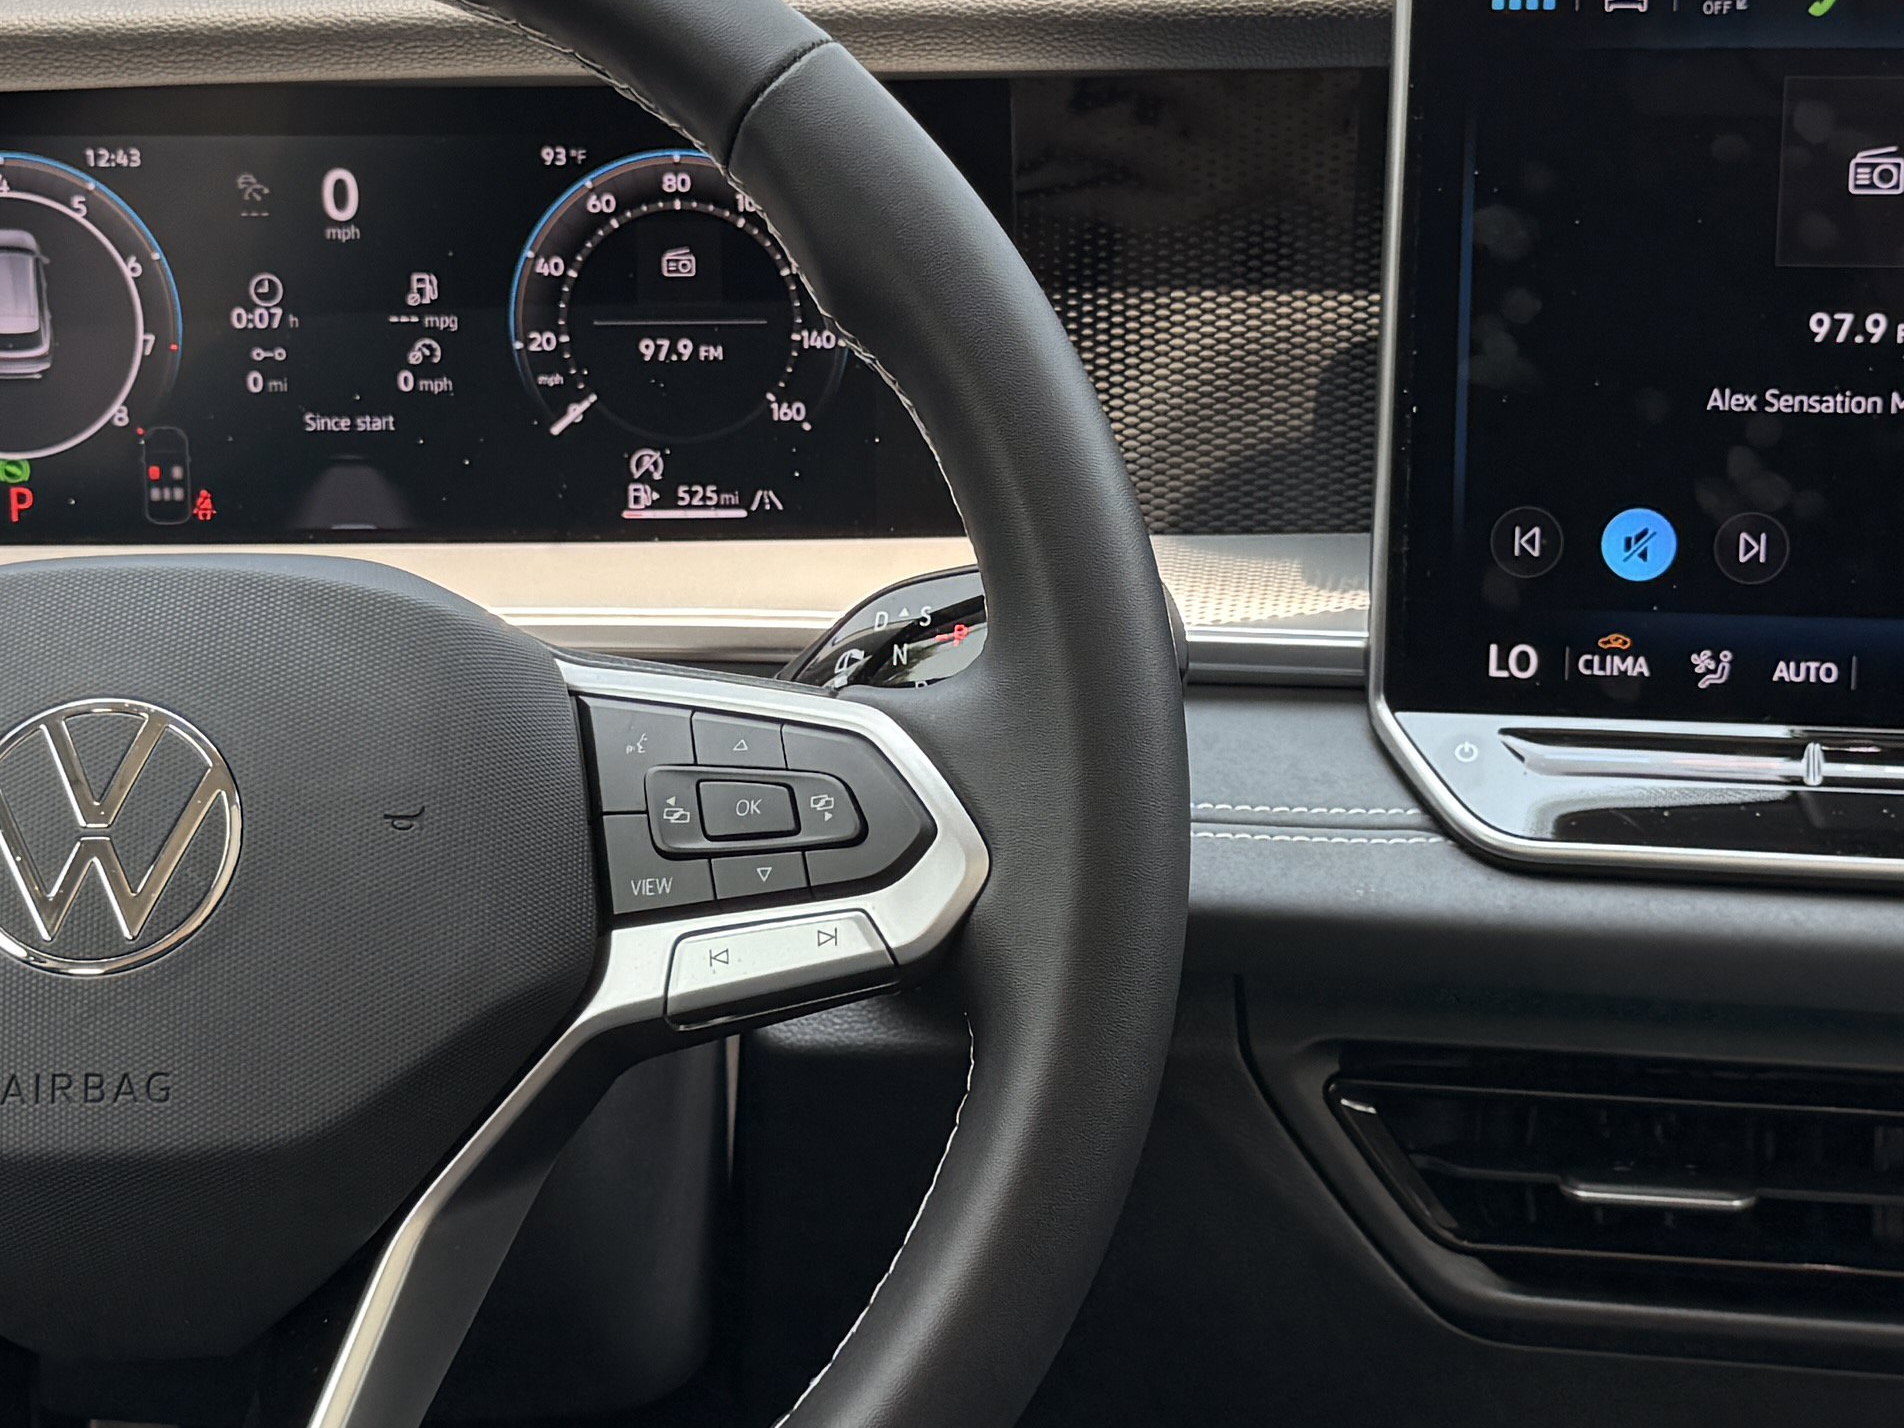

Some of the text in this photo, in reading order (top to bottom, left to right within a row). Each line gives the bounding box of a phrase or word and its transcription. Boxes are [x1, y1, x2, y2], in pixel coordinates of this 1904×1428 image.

[85, 147, 141, 168] 12:43
[541, 146, 567, 166] 93
[322, 167, 359, 222] 0
[661, 174, 692, 193] 80
[72, 196, 88, 218] 5
[586, 193, 617, 214] 60
[325, 224, 361, 243] mph
[127, 256, 143, 278] 6
[536, 256, 564, 277] 40
[230, 307, 299, 329] 0:07 h
[423, 315, 458, 332] mpg
[1809, 312, 1888, 344] 97.9
[143, 333, 156, 356] 7
[528, 332, 557, 352] 20
[638, 338, 724, 362] 97.9 FM
[801, 329, 836, 349] 140
[246, 370, 288, 393] 0 mi
[397, 369, 453, 395] 0 mph
[1706, 387, 1758, 412] Alex
[1764, 388, 1883, 415] Sensation
[112, 406, 129, 427] 8
[304, 412, 396, 432] Since start
[770, 403, 807, 422] 160
[8, 486, 34, 523] P
[677, 484, 740, 506] 525 mi
[873, 606, 933, 630] D S
[891, 644, 909, 666] N
[1488, 643, 1539, 679] LO
[1578, 654, 1650, 677] CLIMA
[1772, 660, 1839, 684] AUTO
[735, 798, 762, 817] OK
[630, 877, 673, 896] VIEW
[0, 1072, 173, 1105] AIRBAG
